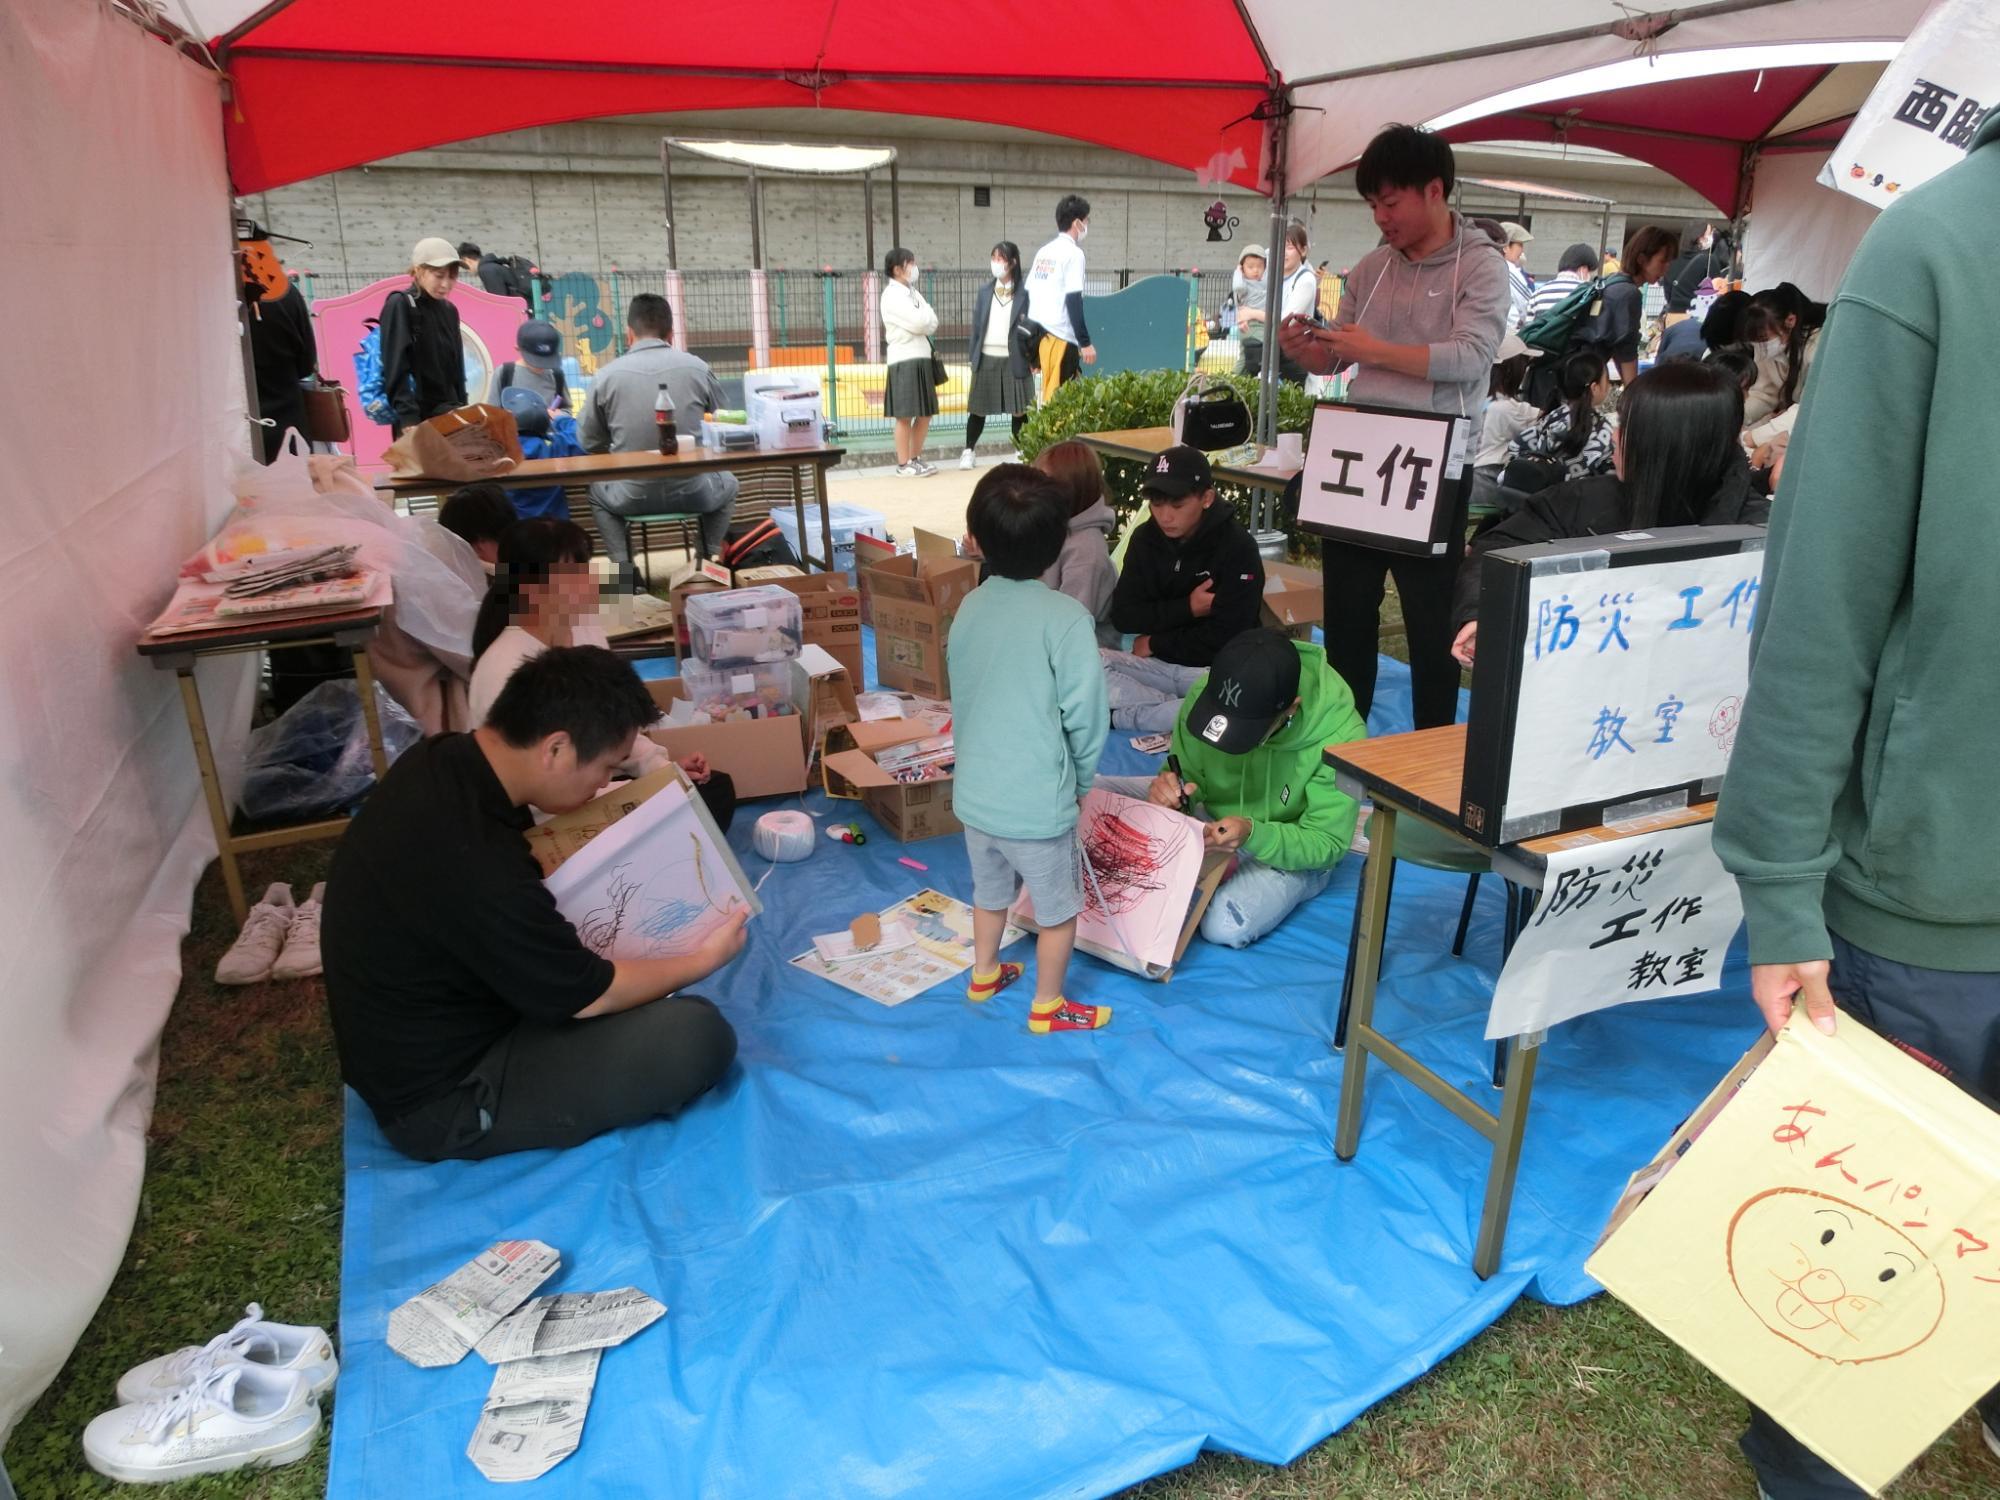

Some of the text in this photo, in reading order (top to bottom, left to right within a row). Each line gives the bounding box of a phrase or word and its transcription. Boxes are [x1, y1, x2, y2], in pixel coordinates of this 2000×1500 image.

[1156, 455, 1170, 473] LA
[1320, 443, 1432, 511] 工作
[1218, 677, 1242, 708] NY
[1586, 694, 1684, 760] 教室
[1535, 848, 1664, 927] 防災
[1589, 896, 1702, 949] 工作
[1627, 947, 1708, 989] 教室
